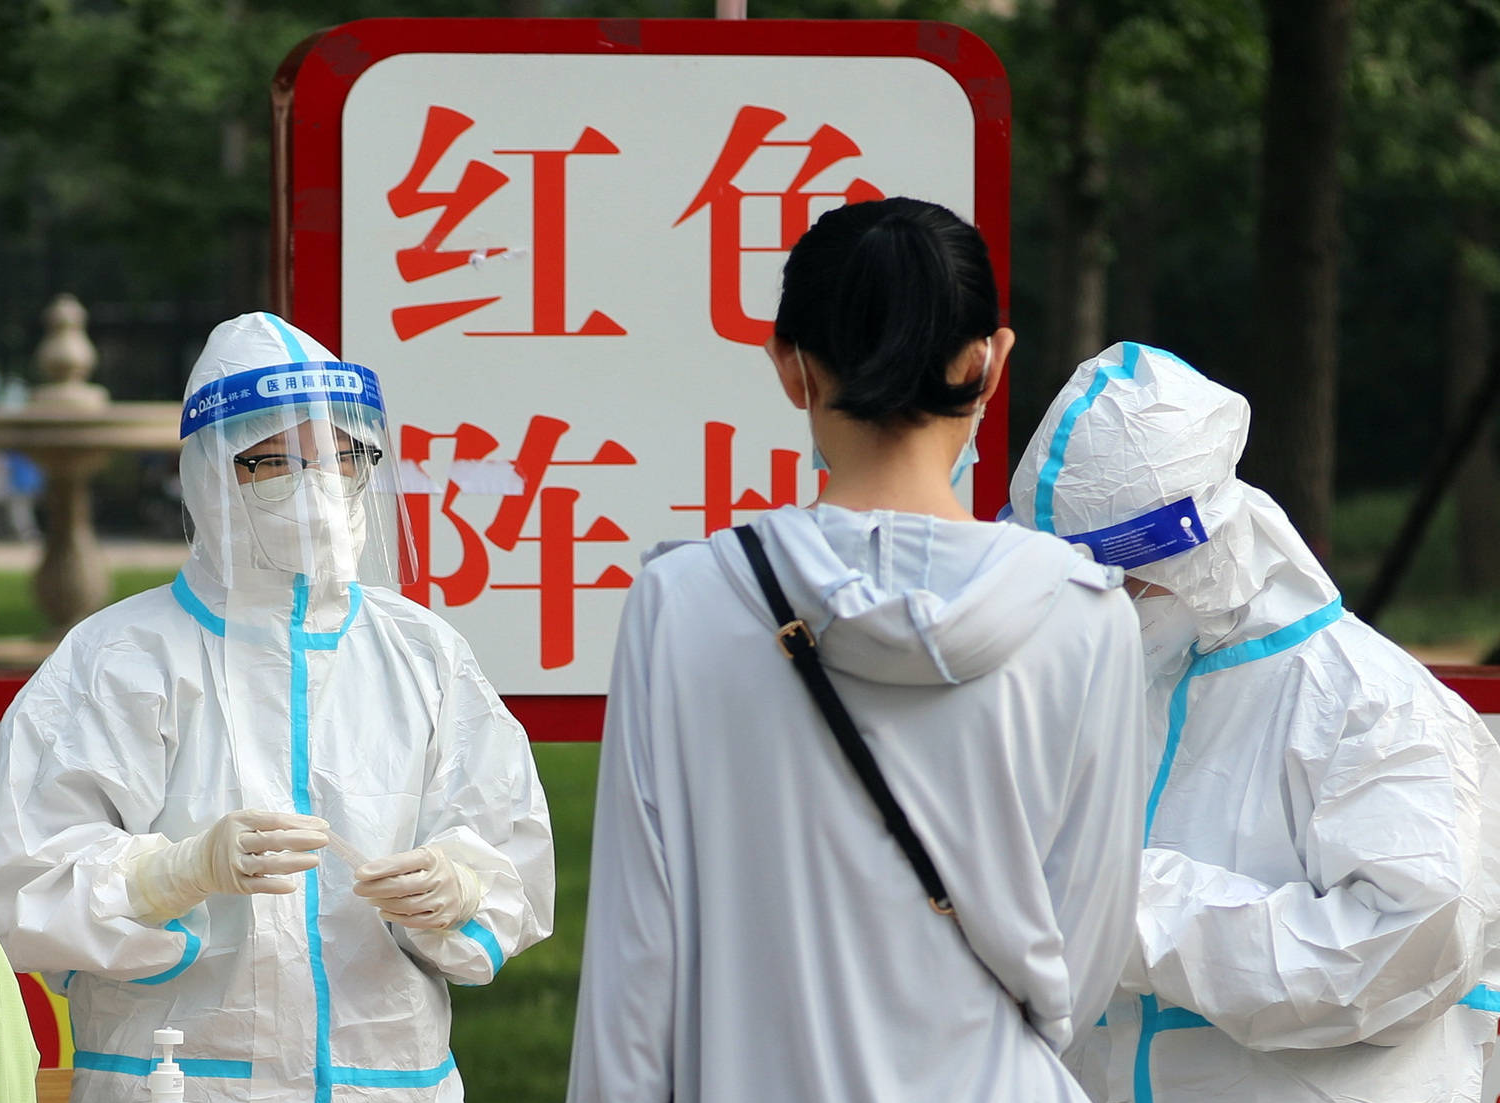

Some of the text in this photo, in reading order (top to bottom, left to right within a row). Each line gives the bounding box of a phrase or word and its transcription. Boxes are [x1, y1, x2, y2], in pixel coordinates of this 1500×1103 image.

[266, 374, 358, 392] 医用隔离面罩
